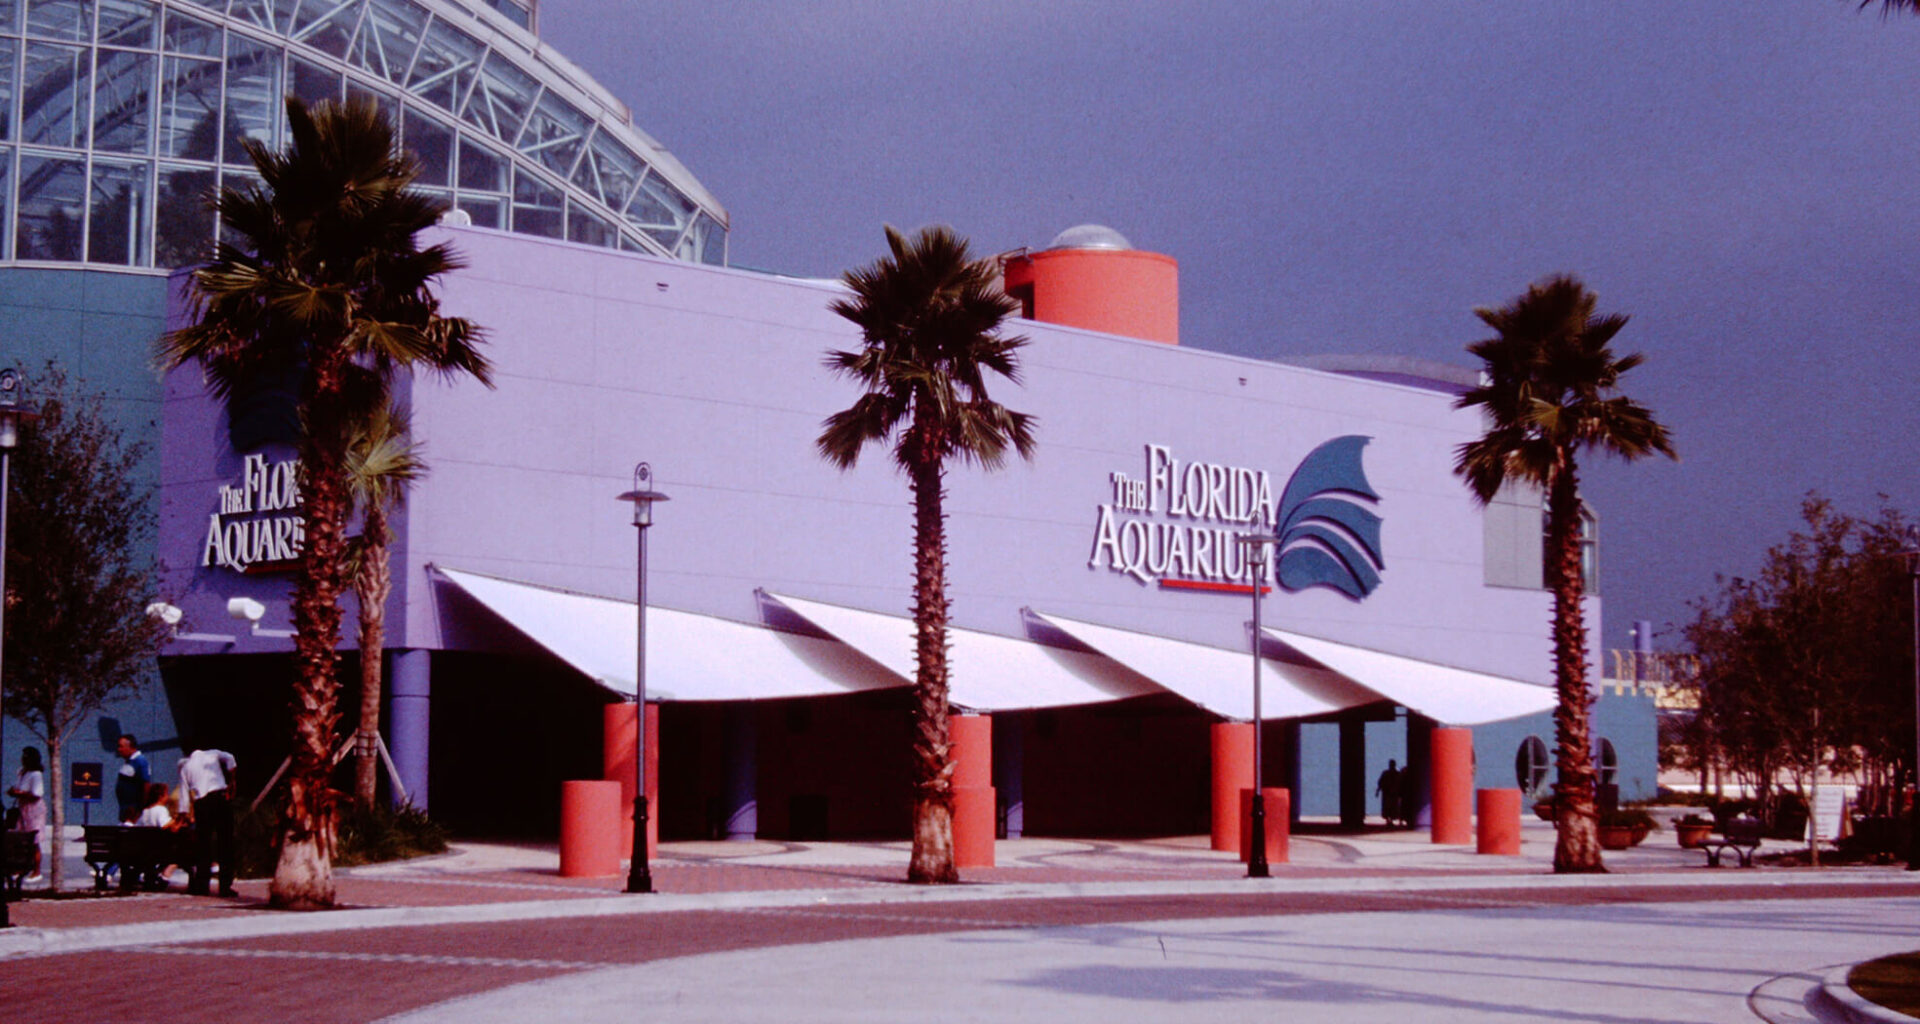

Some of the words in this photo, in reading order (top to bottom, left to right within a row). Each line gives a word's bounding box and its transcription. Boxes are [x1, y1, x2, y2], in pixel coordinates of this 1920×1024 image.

[1112, 471, 1146, 510] THE
[1147, 443, 1276, 525] FLORIDA
[201, 513, 305, 573] AQUARI
[1090, 503, 1273, 582] AQUARIUM
